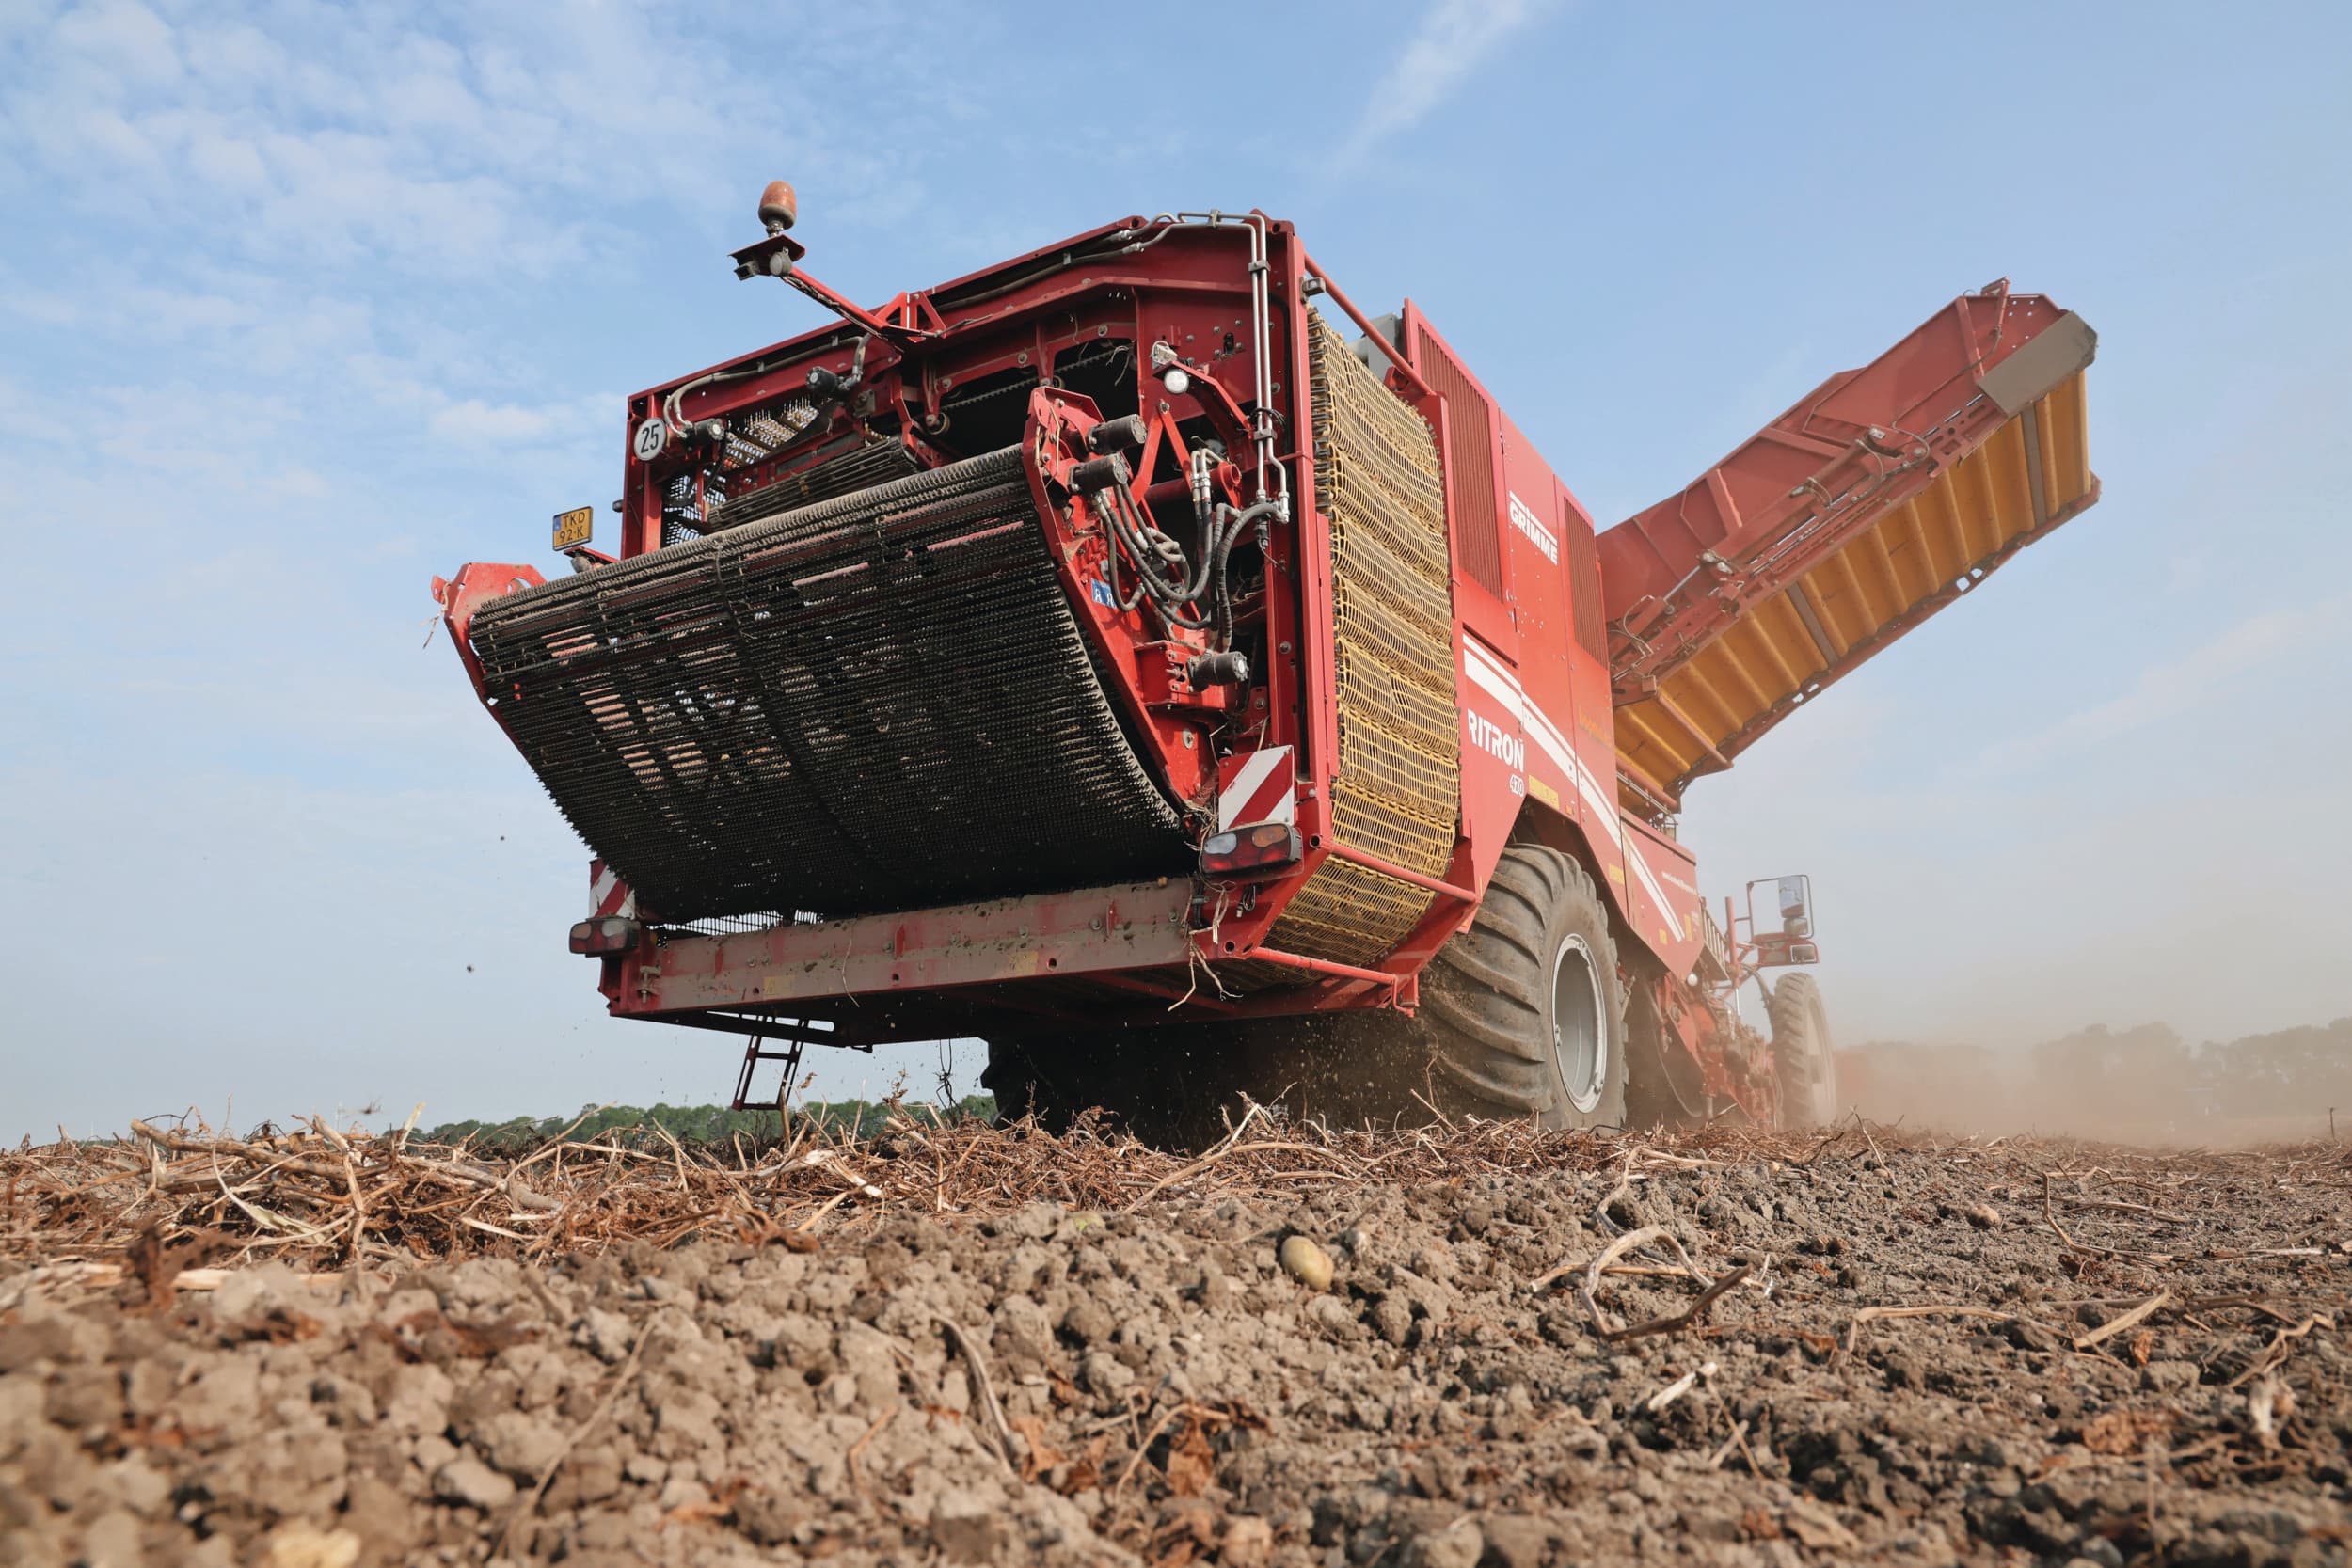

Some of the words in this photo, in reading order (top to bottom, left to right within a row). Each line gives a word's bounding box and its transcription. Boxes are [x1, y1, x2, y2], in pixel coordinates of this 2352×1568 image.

[641, 423, 660, 453] 25
[563, 512, 585, 528] TKD
[1509, 500, 1558, 565] GRIMME
[1467, 708, 1524, 772] RITRON
